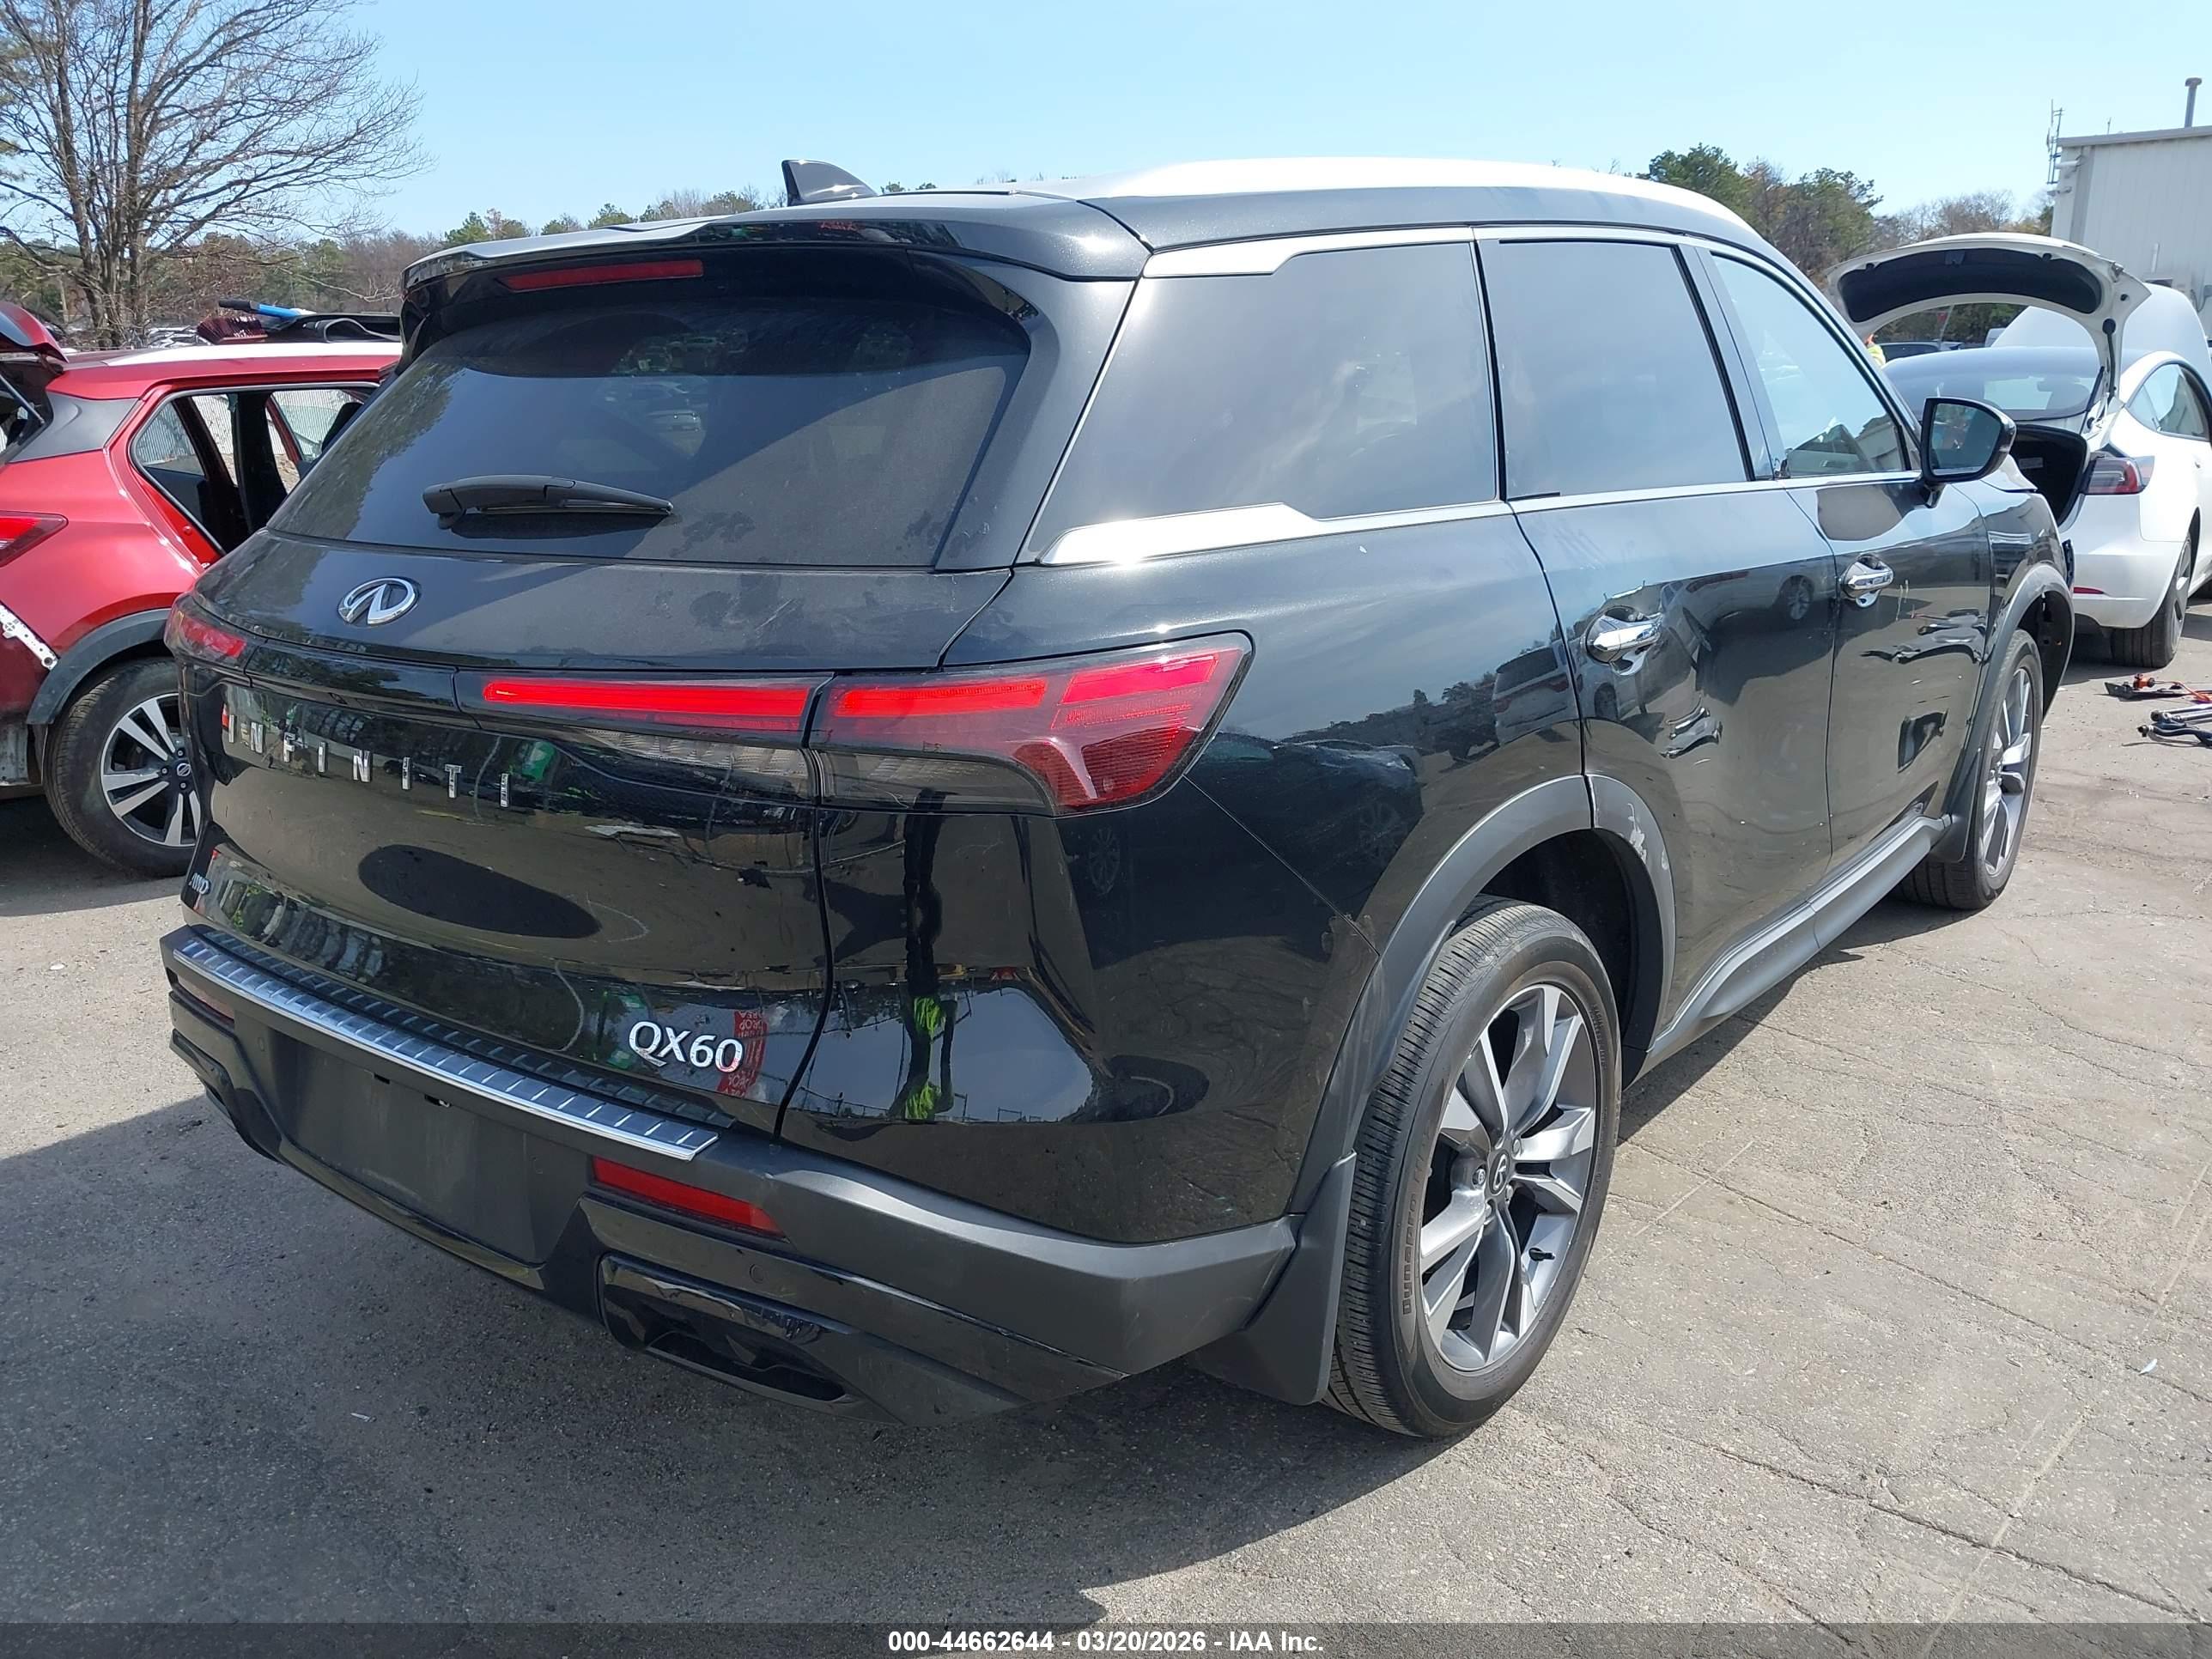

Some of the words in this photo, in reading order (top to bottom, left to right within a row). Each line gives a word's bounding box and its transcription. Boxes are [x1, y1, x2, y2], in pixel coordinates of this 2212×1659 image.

[228, 714, 510, 808] INFINITI
[629, 1021, 744, 1073] QX60
[1401, 1192, 1417, 1316] Dynapro
